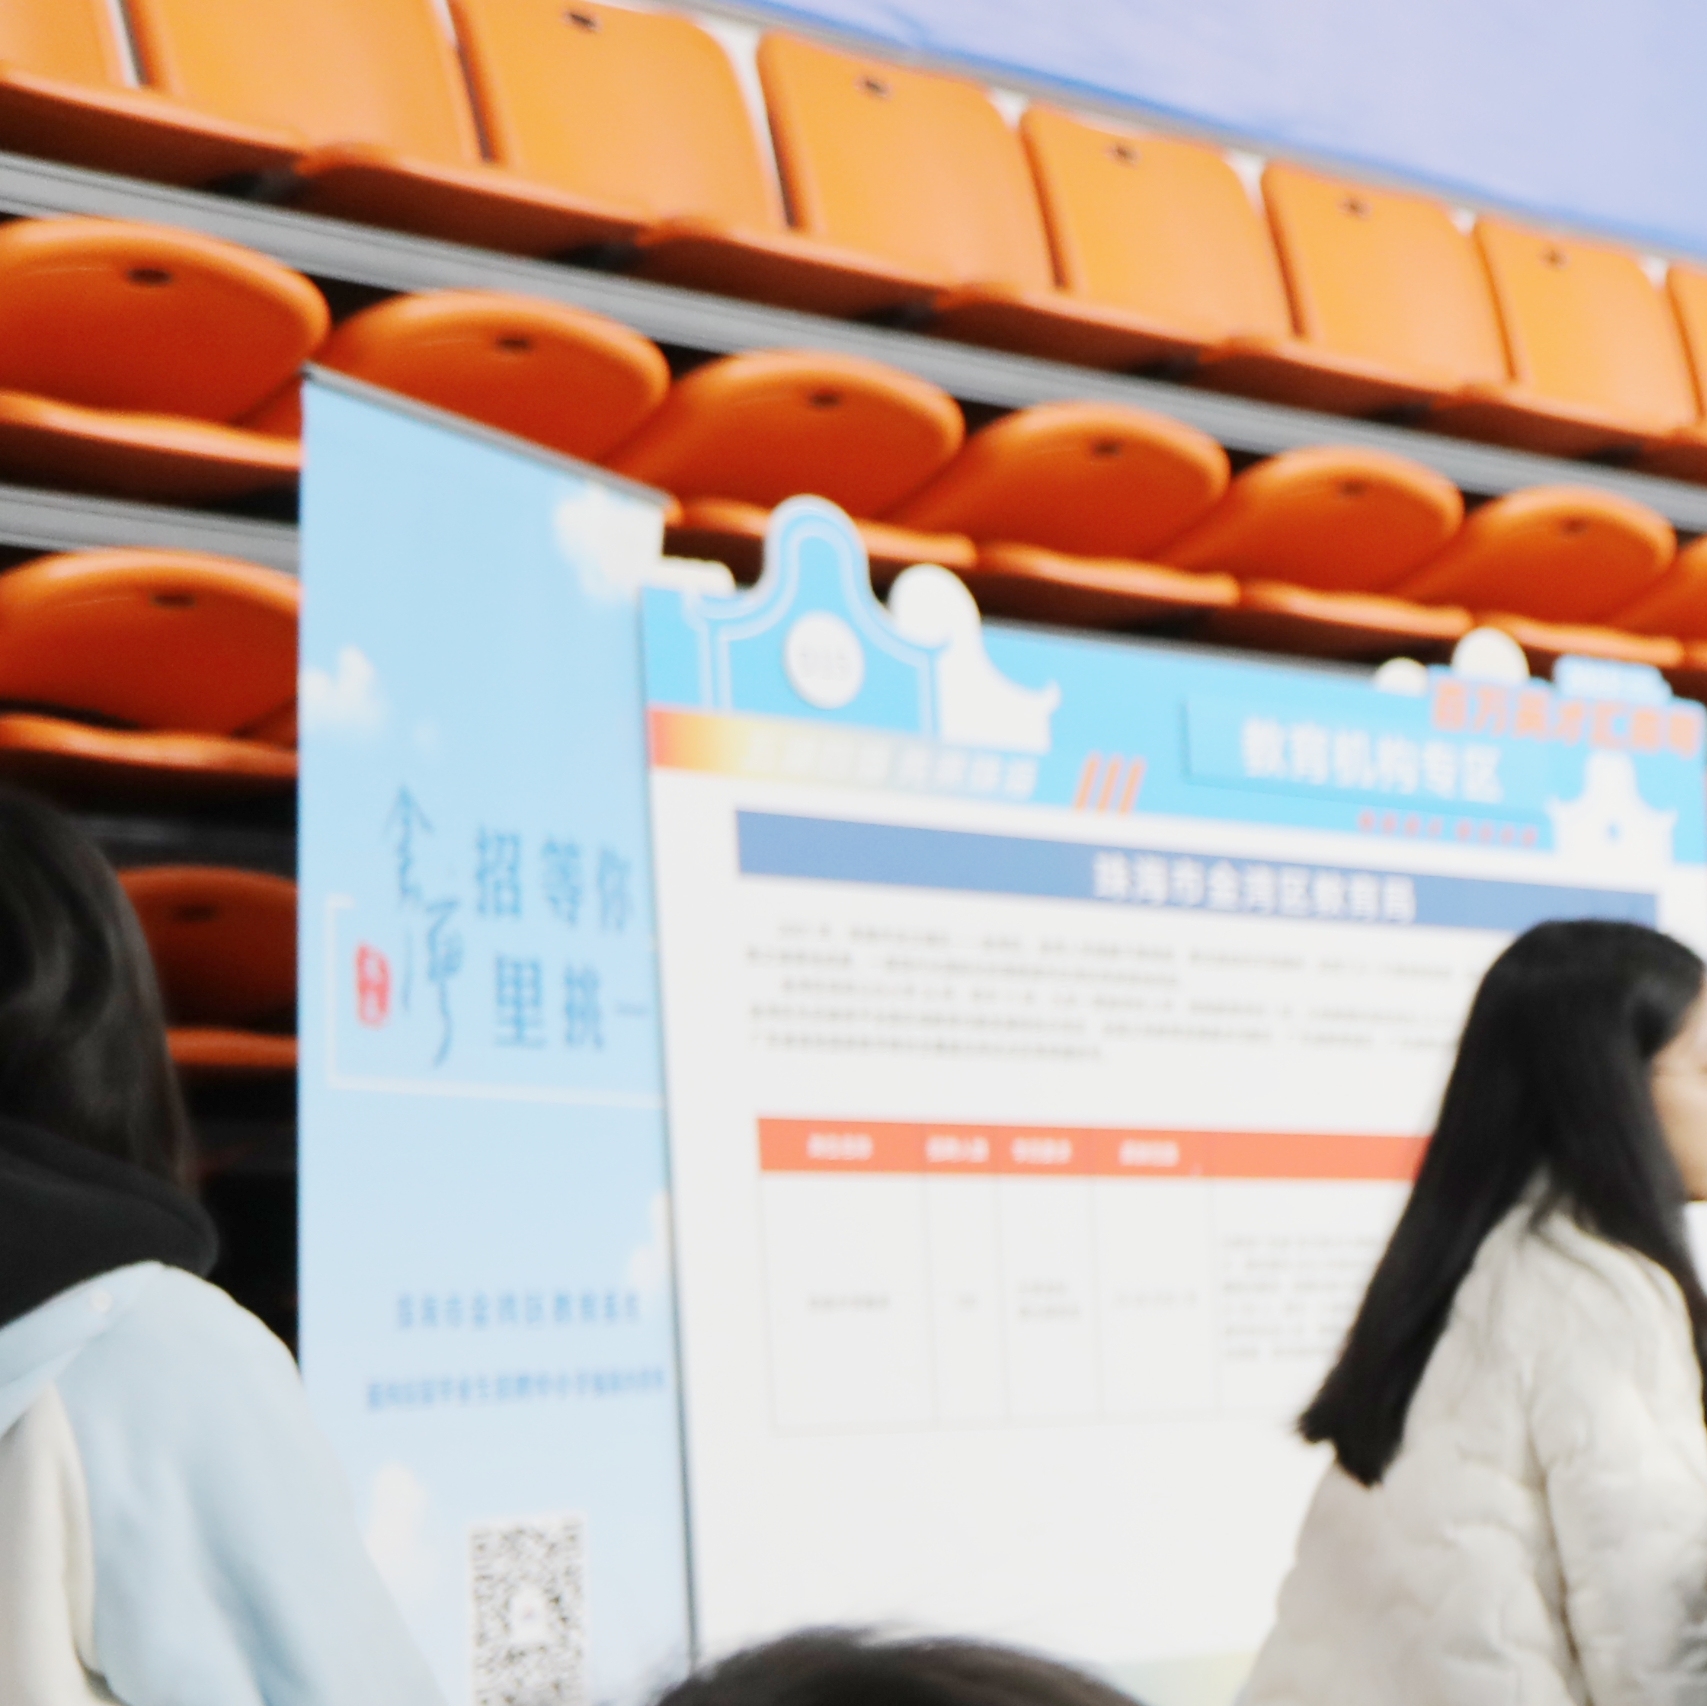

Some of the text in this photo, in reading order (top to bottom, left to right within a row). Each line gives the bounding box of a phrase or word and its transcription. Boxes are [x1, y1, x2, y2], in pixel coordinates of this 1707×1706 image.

[1240, 715, 1504, 804] 教育机构专区
